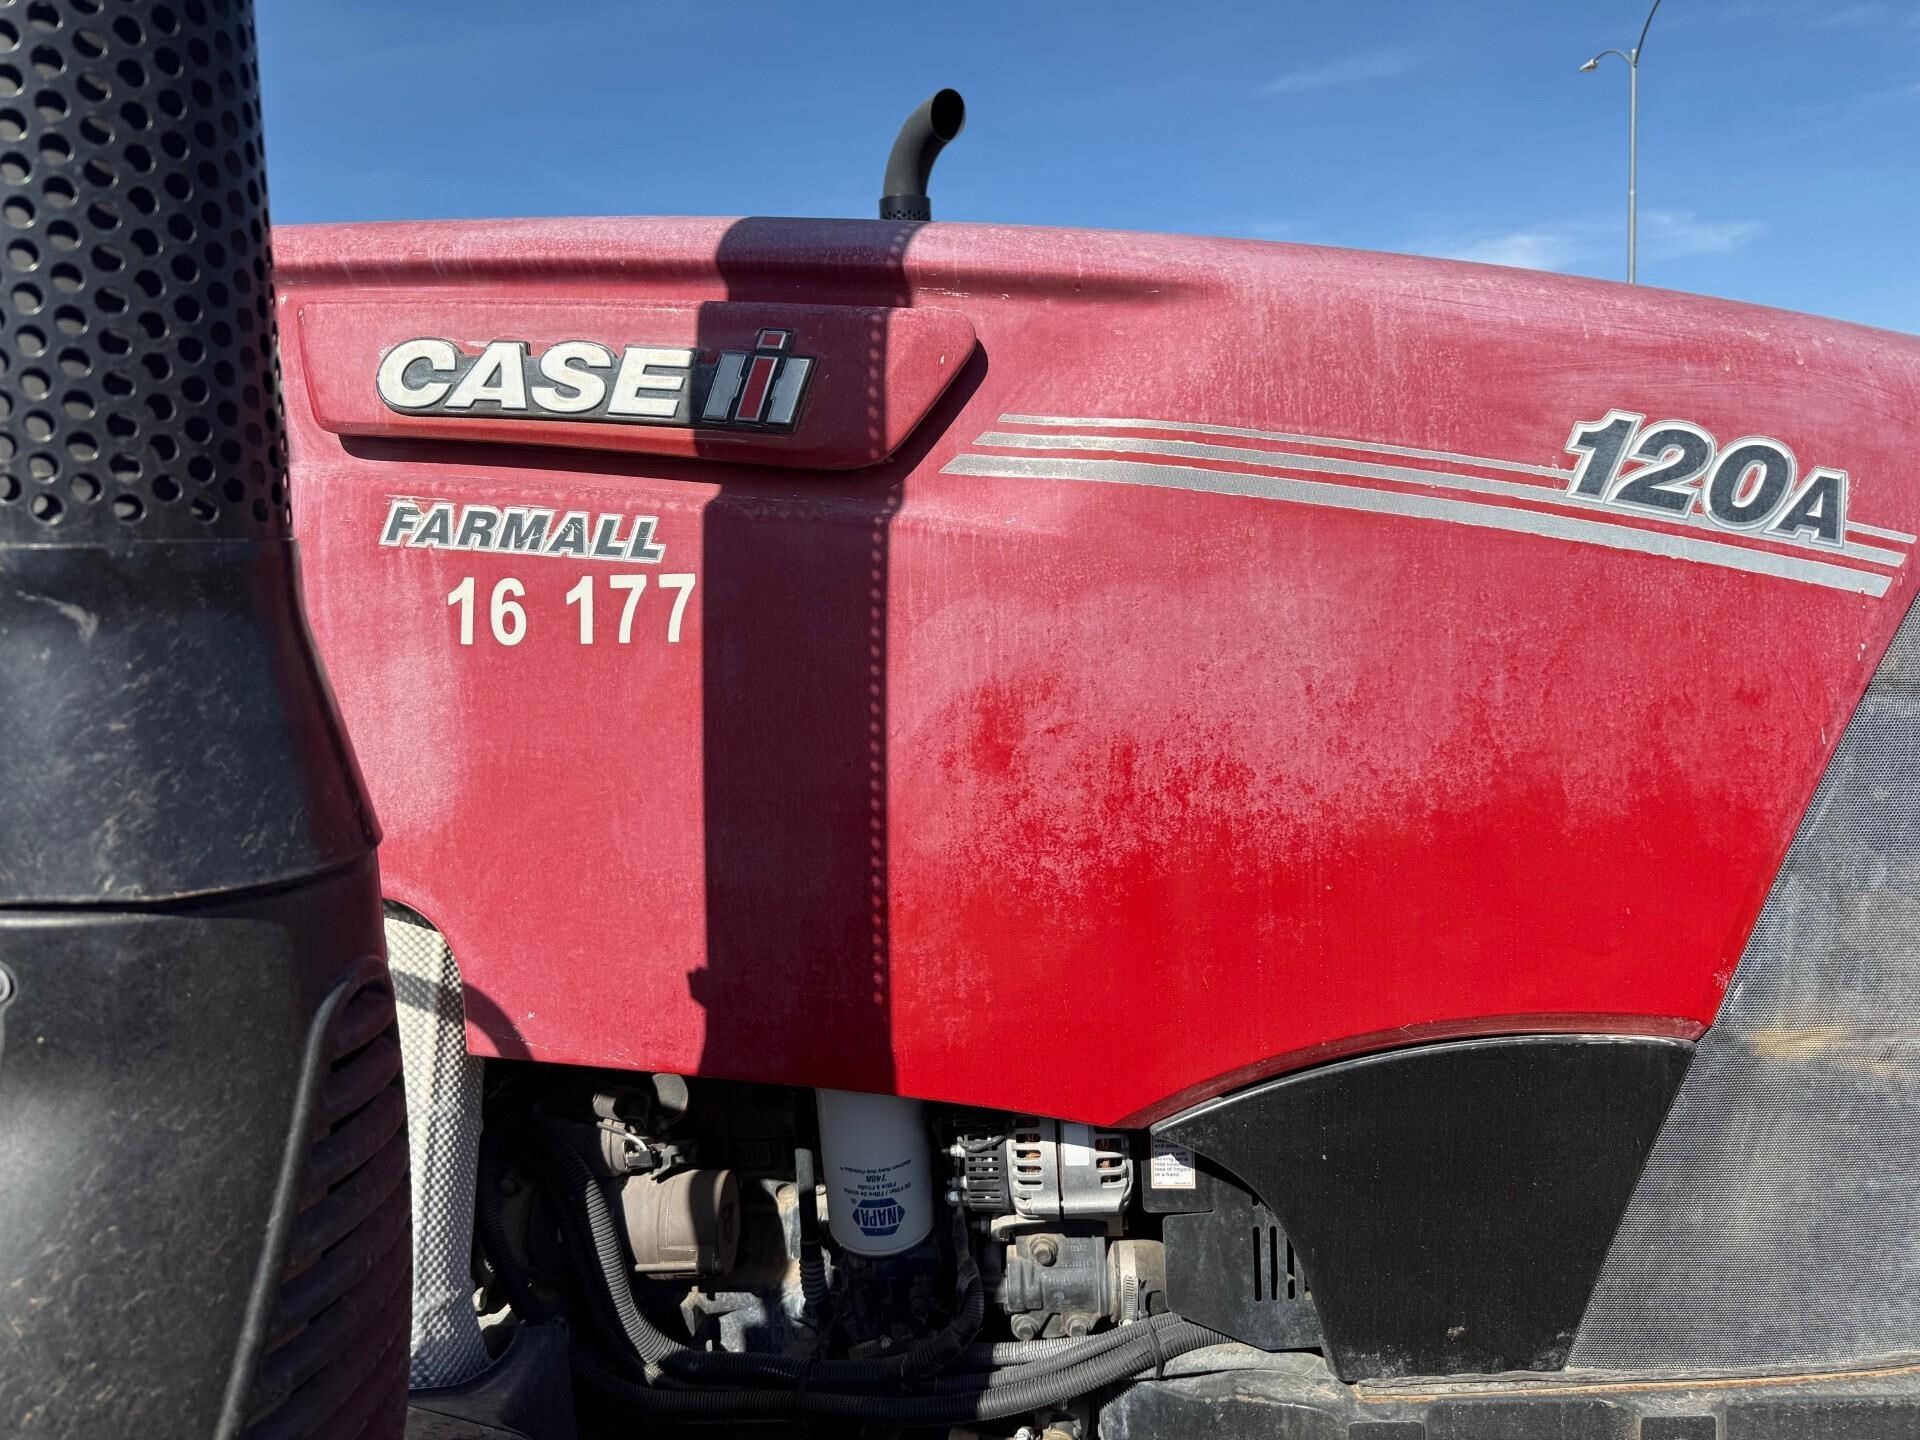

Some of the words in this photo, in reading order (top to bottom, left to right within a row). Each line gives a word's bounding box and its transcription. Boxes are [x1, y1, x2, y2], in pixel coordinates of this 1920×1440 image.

[377, 339, 695, 418] CASE
[1565, 408, 1847, 548] 120A
[379, 499, 666, 563] FARMALL
[447, 577, 527, 646] 16
[565, 574, 696, 645] 177
[860, 1207, 897, 1226] NAPA
